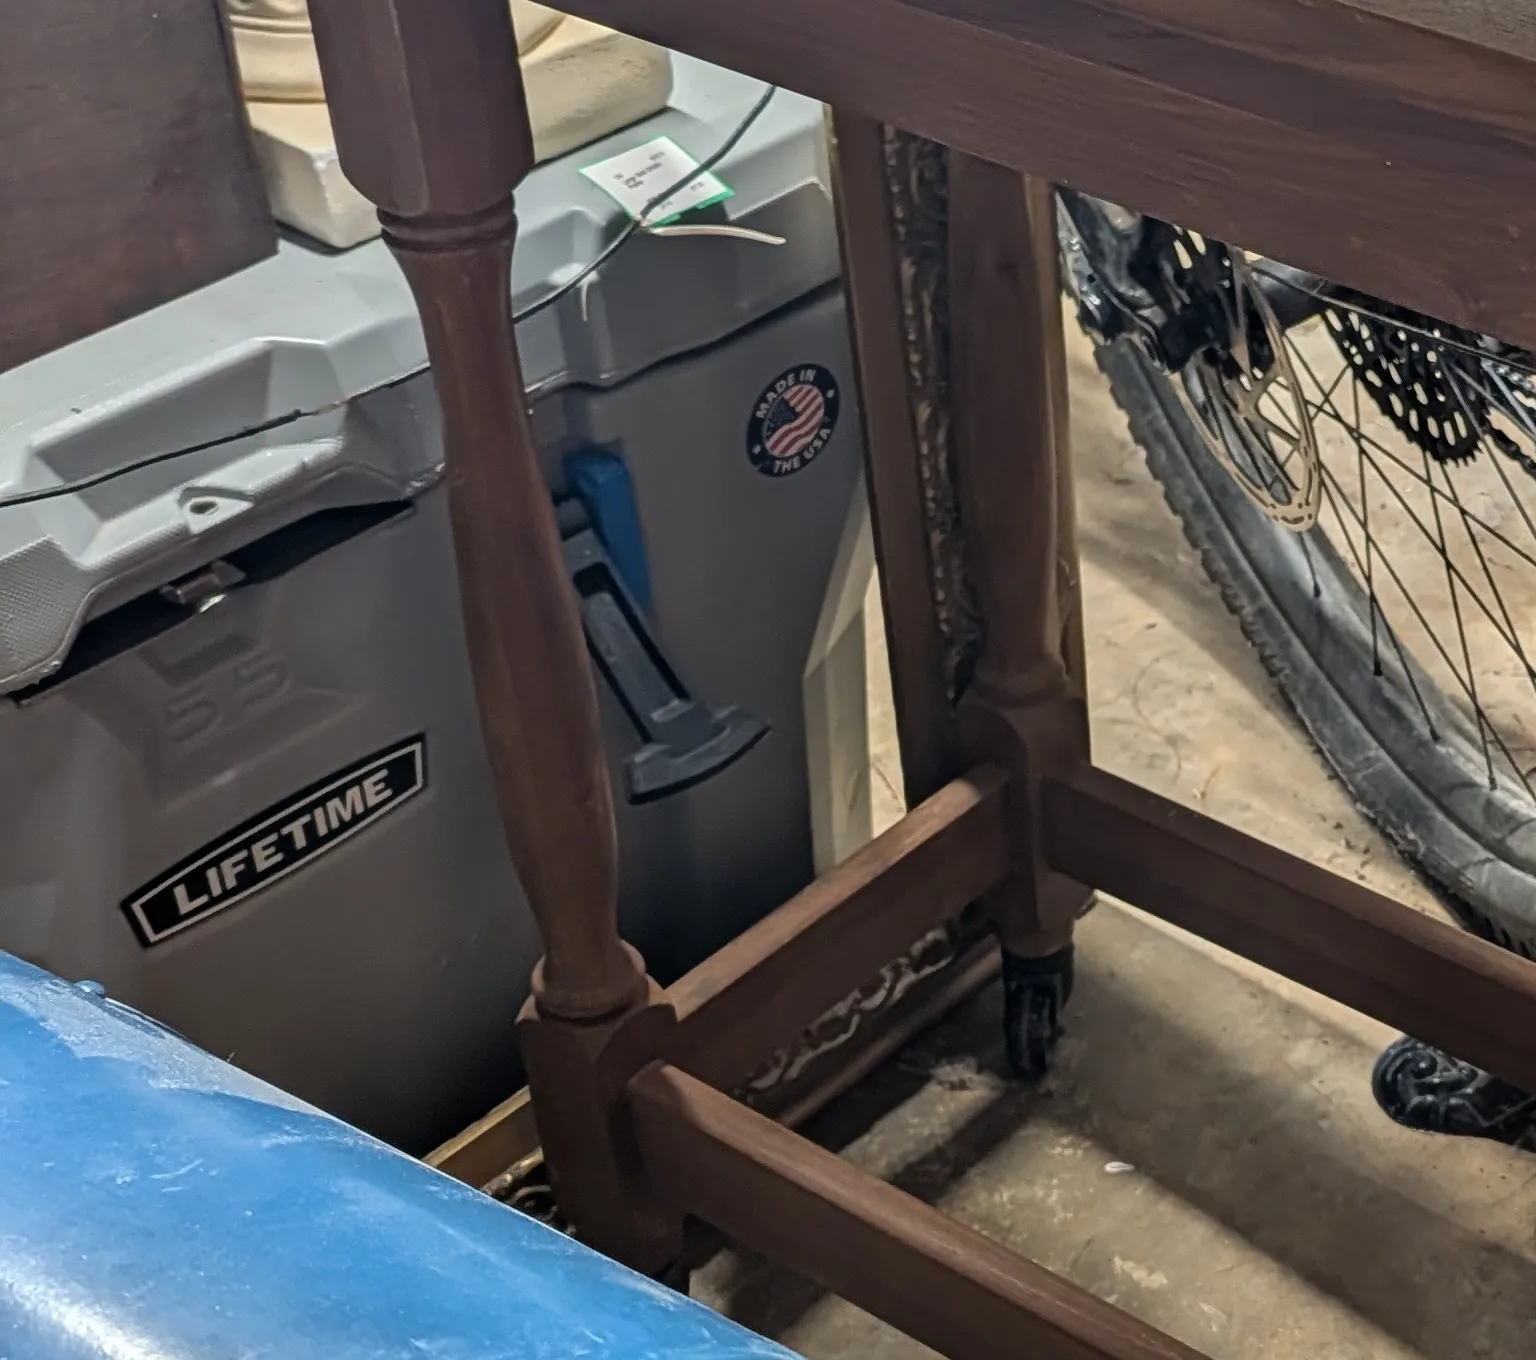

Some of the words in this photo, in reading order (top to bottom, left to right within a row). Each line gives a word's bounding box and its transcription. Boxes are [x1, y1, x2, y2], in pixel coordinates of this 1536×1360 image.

[756, 373, 795, 418] MADE
[800, 369, 816, 381] IN
[773, 456, 800, 473] THE
[803, 429, 831, 459] USA
[172, 768, 393, 915] LIFETIME
